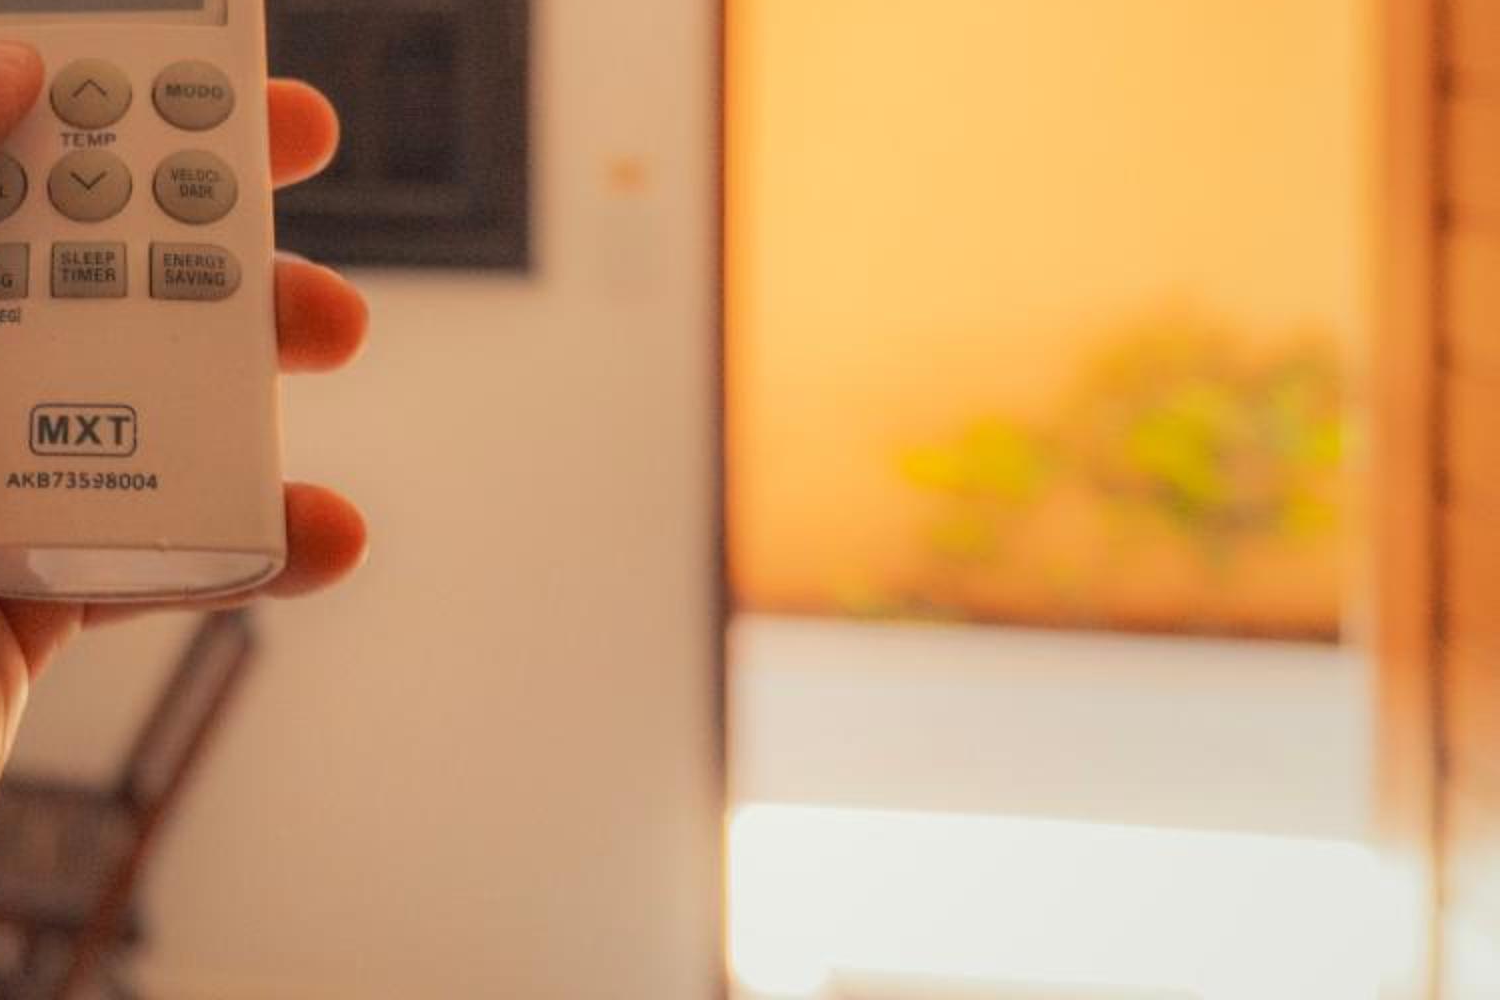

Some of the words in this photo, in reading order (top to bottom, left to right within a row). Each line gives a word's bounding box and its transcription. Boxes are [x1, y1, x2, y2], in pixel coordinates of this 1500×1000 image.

[60, 132, 117, 148] TEMP
[60, 251, 116, 266] SLEEP
[163, 253, 226, 268] ENERGY
[60, 267, 117, 283] TIMER
[165, 269, 226, 288] SAVING
[37, 414, 131, 446] MXT
[6, 471, 158, 491] AKB73598004
